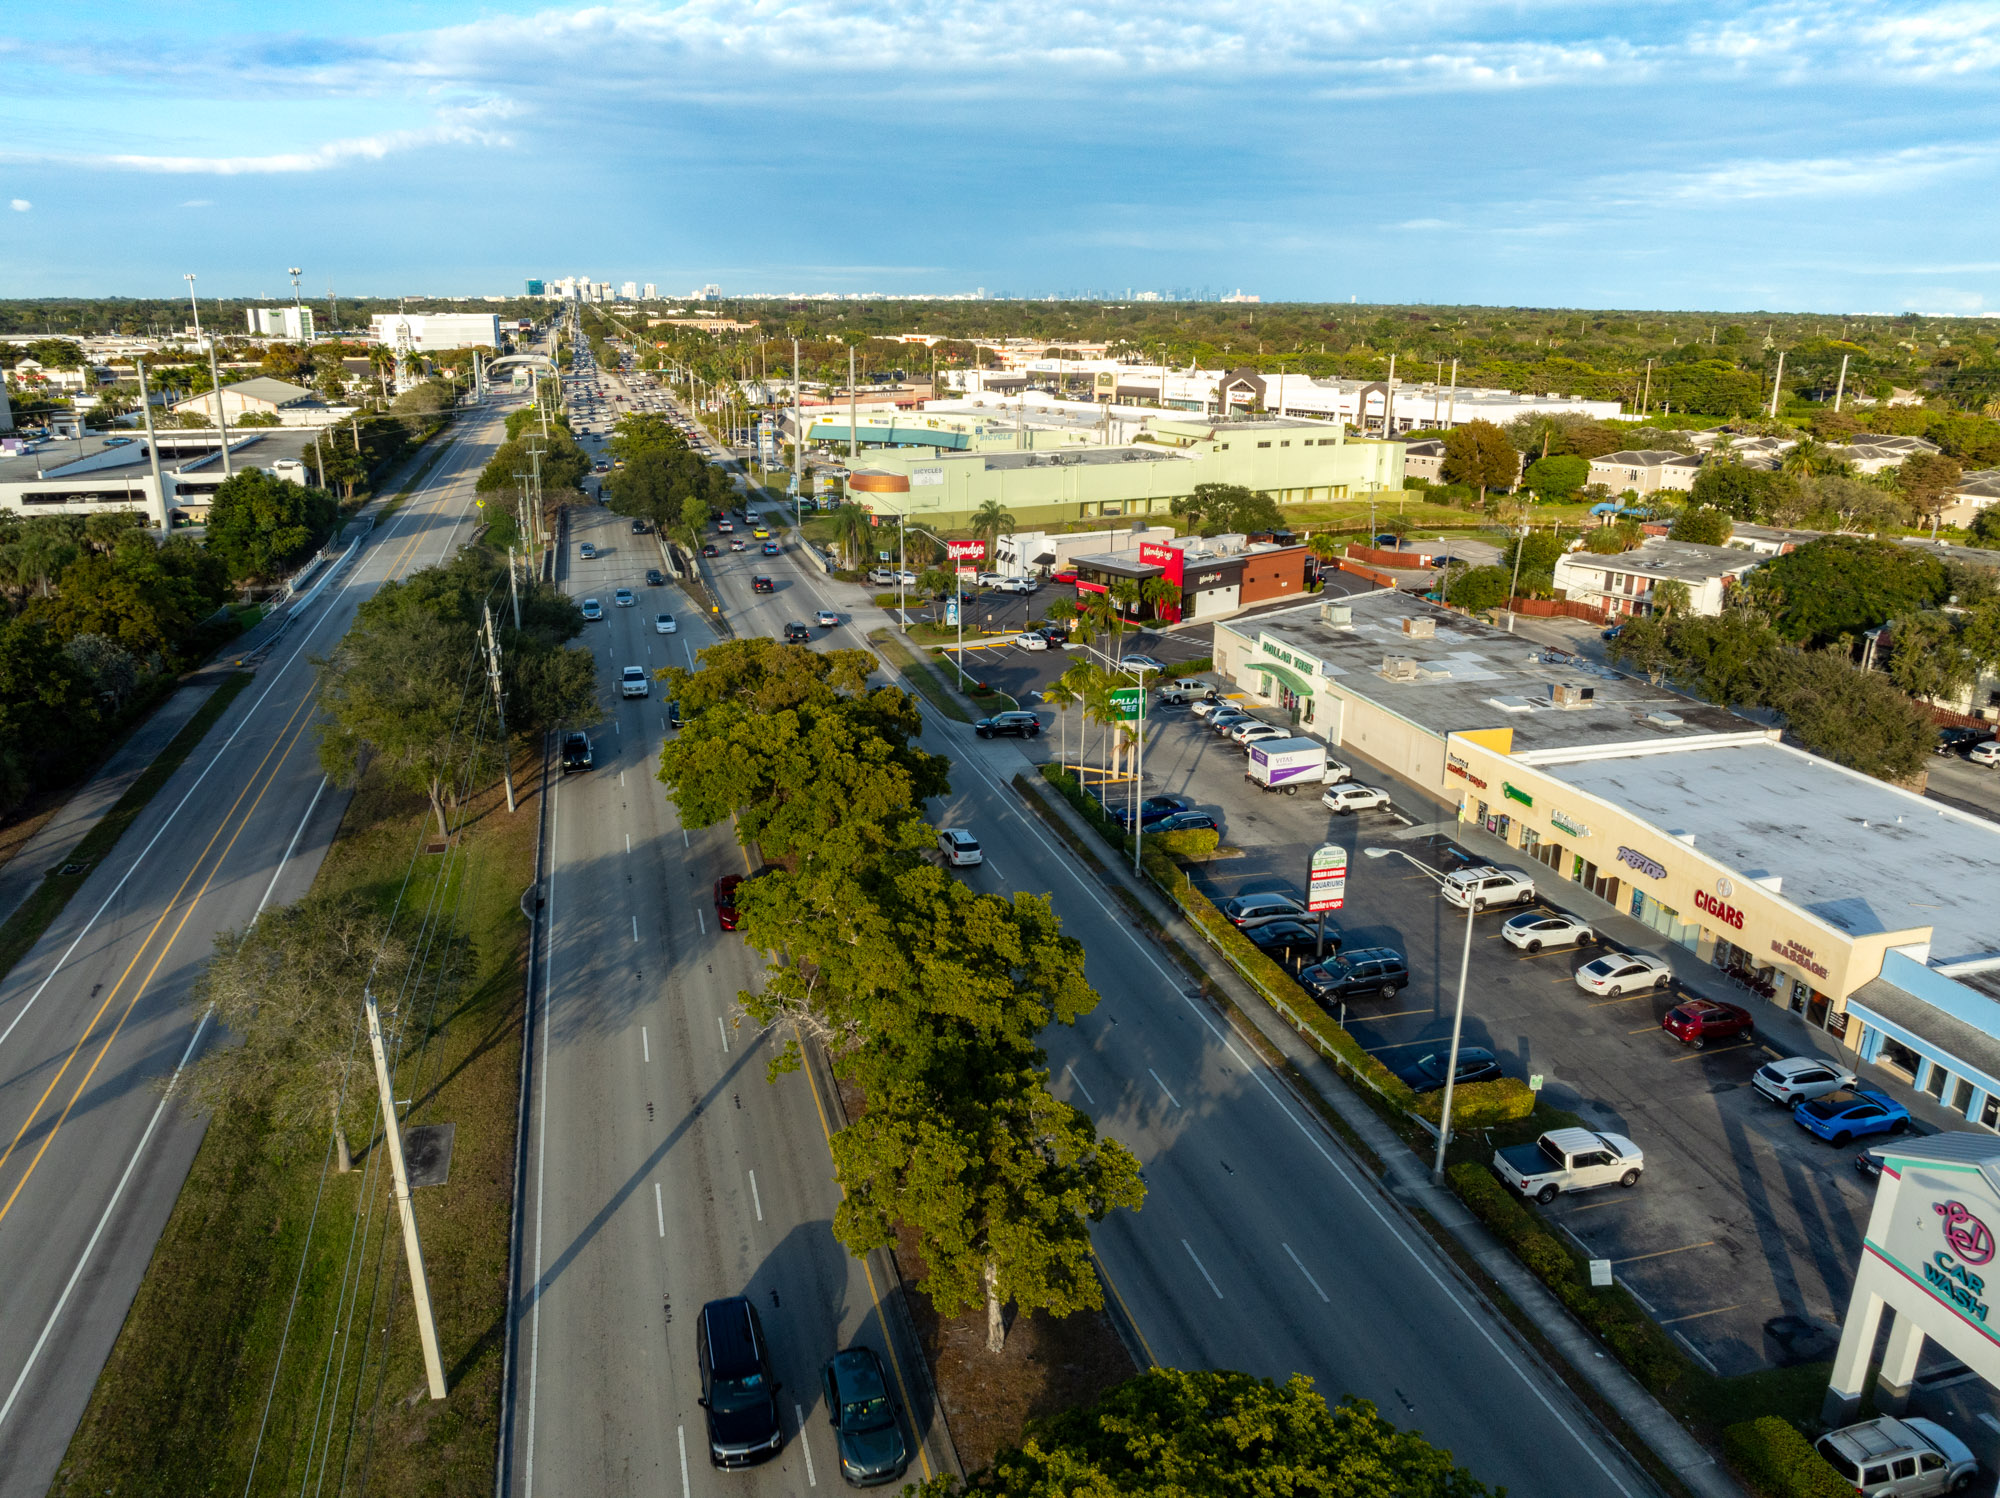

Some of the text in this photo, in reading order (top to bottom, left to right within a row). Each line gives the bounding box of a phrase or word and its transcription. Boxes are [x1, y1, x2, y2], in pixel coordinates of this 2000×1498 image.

[948, 542, 985, 559] Wendy's
[1143, 546, 1164, 559] Wendy's
[1199, 573, 1215, 585] Wendy's
[1263, 641, 1314, 675] DOLLAR TREE
[1276, 756, 1293, 764] VITAS
[1616, 846, 1667, 880] REEFTOP
[1311, 879, 1344, 889] AQUARIUMS
[1694, 889, 1745, 930] CIGARS
[1771, 939, 1829, 980] MASSAGE
[1787, 940, 1815, 959] ASIAN
[1934, 1251, 1985, 1297] CAR
[1922, 1260, 1990, 1322] WASH
